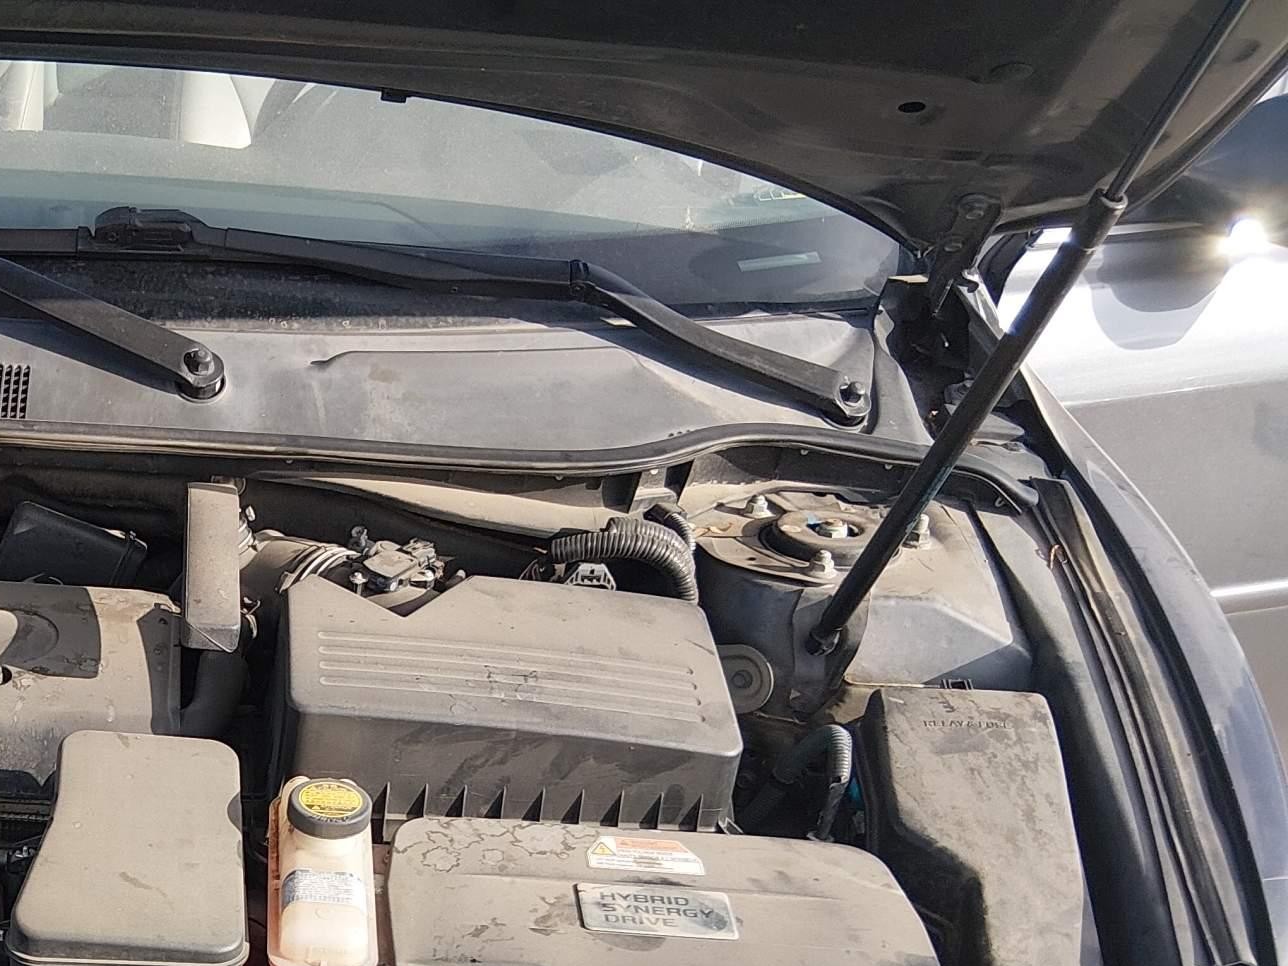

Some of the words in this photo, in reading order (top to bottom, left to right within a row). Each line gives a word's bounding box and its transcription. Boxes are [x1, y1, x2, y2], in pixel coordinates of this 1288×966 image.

[599, 892, 689, 906] HYBRID
[601, 903, 714, 919] SYNERGY
[604, 914, 679, 928] DRIVE
